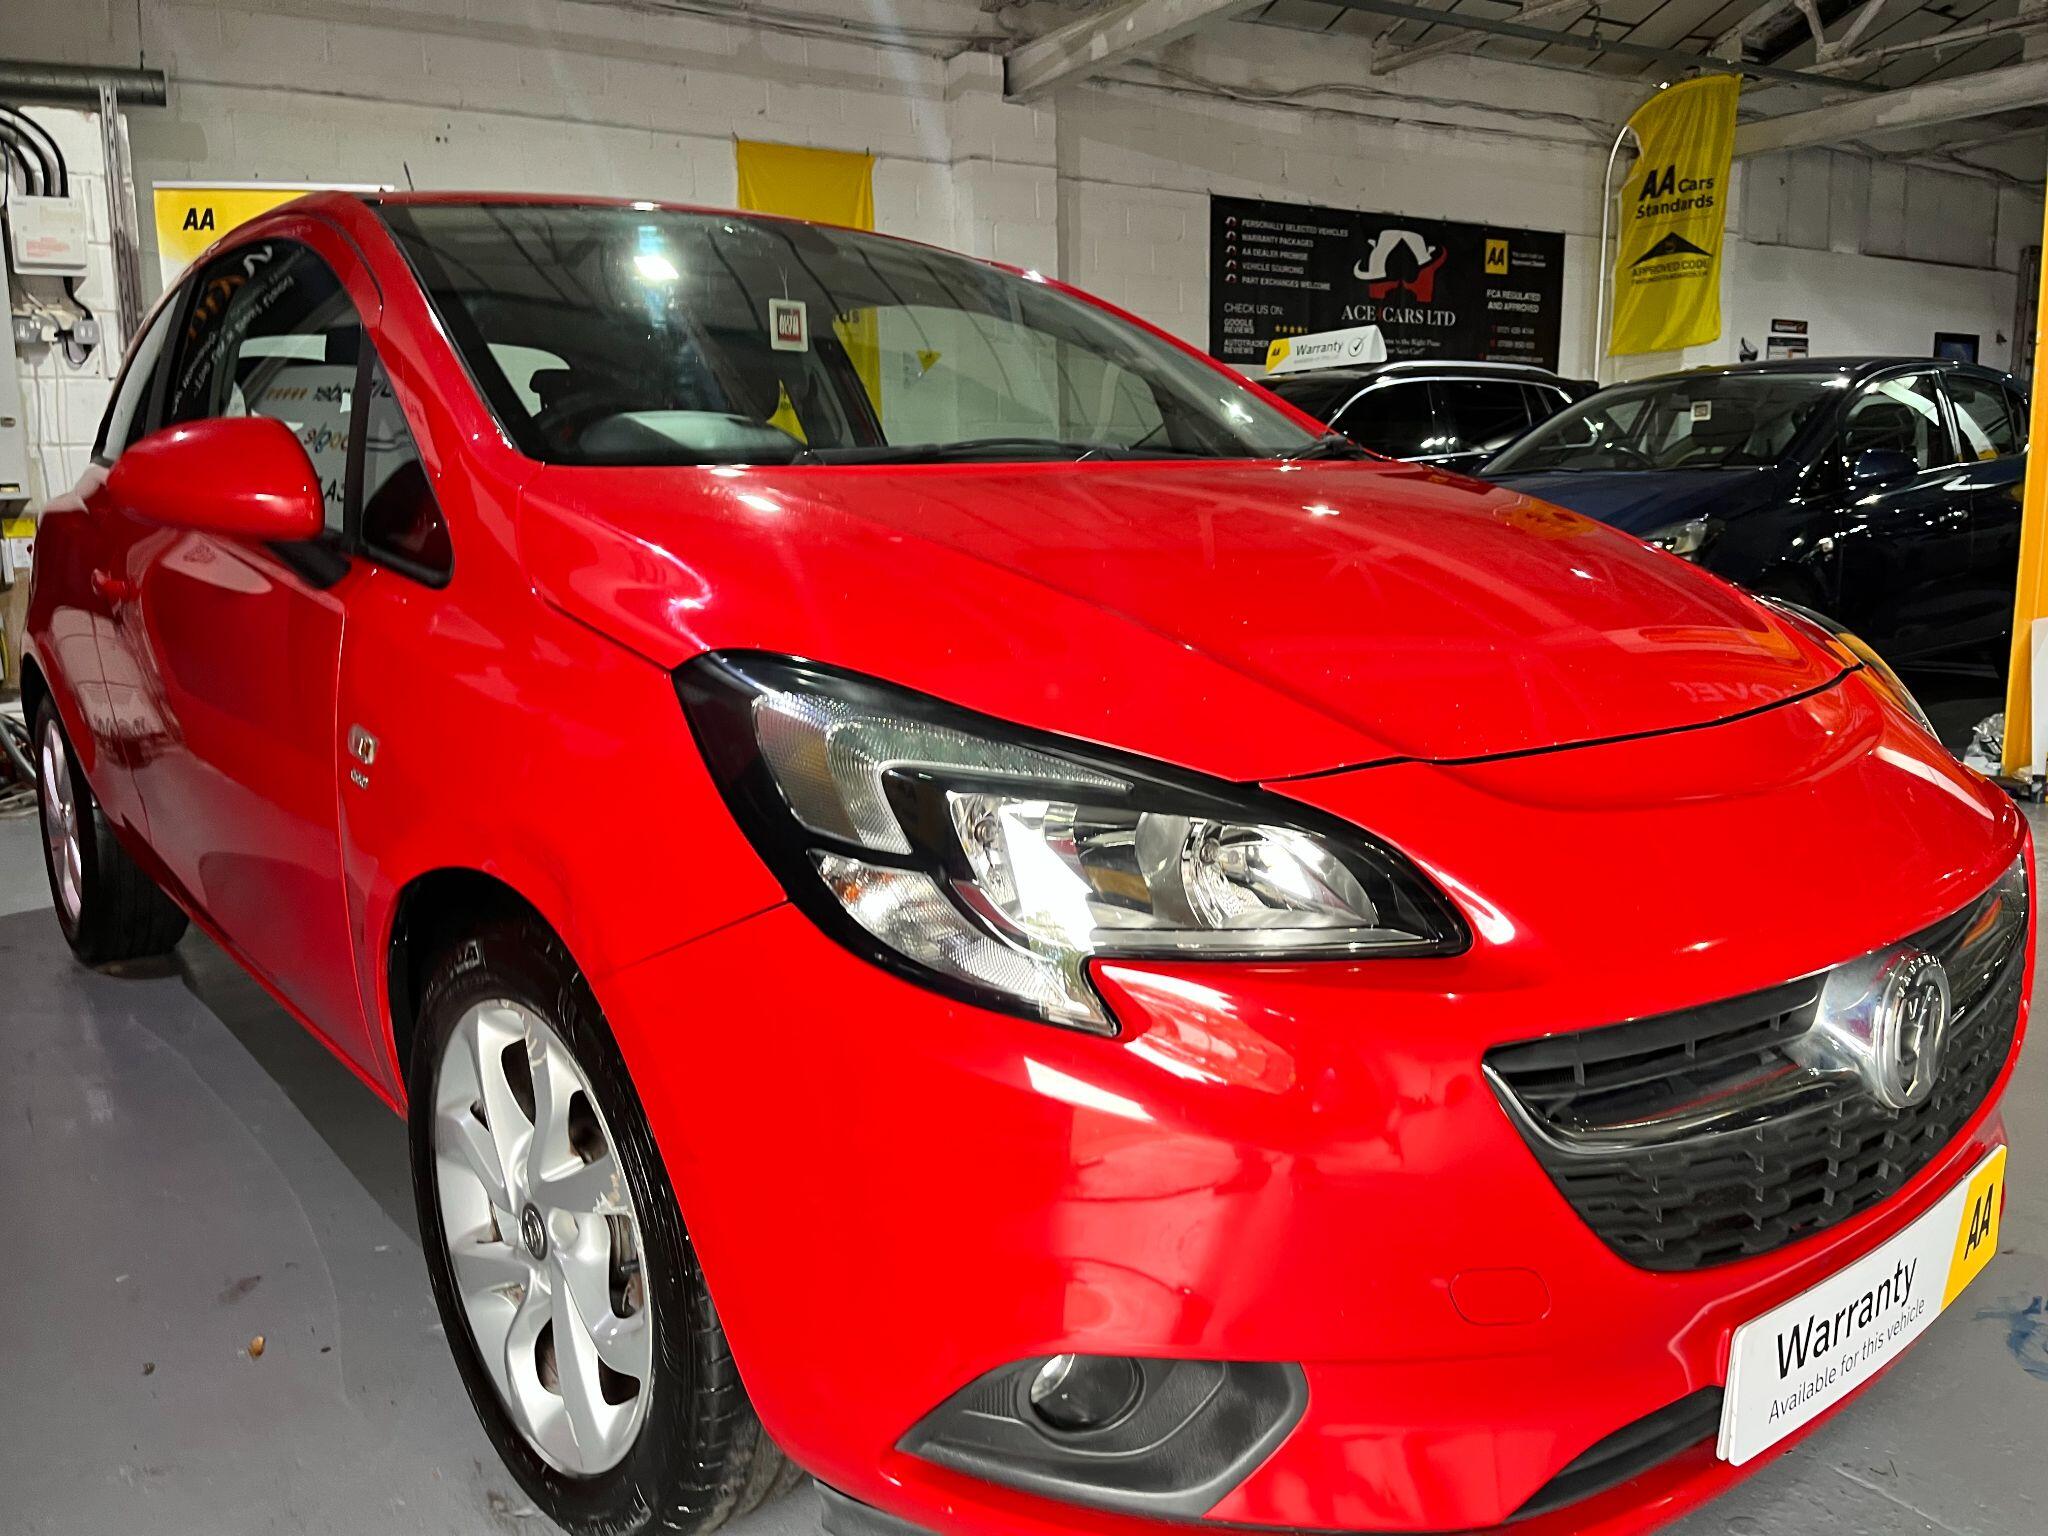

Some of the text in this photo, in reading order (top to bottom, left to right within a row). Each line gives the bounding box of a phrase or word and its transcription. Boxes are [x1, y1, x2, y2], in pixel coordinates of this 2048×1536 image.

[1639, 164, 1714, 202] AA Cars
[1636, 194, 1714, 219] Standards
[183, 207, 215, 231] AA
[1487, 246, 1505, 266] AA
[1224, 303, 1254, 314] CHECK
[1256, 304, 1268, 315] US
[1341, 305, 1456, 326] ACE CARS LTD
[1224, 318, 1253, 327] GOOGLE
[1224, 326, 1255, 335] REVIEWS
[1296, 341, 1343, 356] Warranty
[1964, 1183, 1994, 1260] AA
[1776, 1257, 1918, 1380] Warranty
[1768, 1297, 1926, 1425] Available for this vehicle
